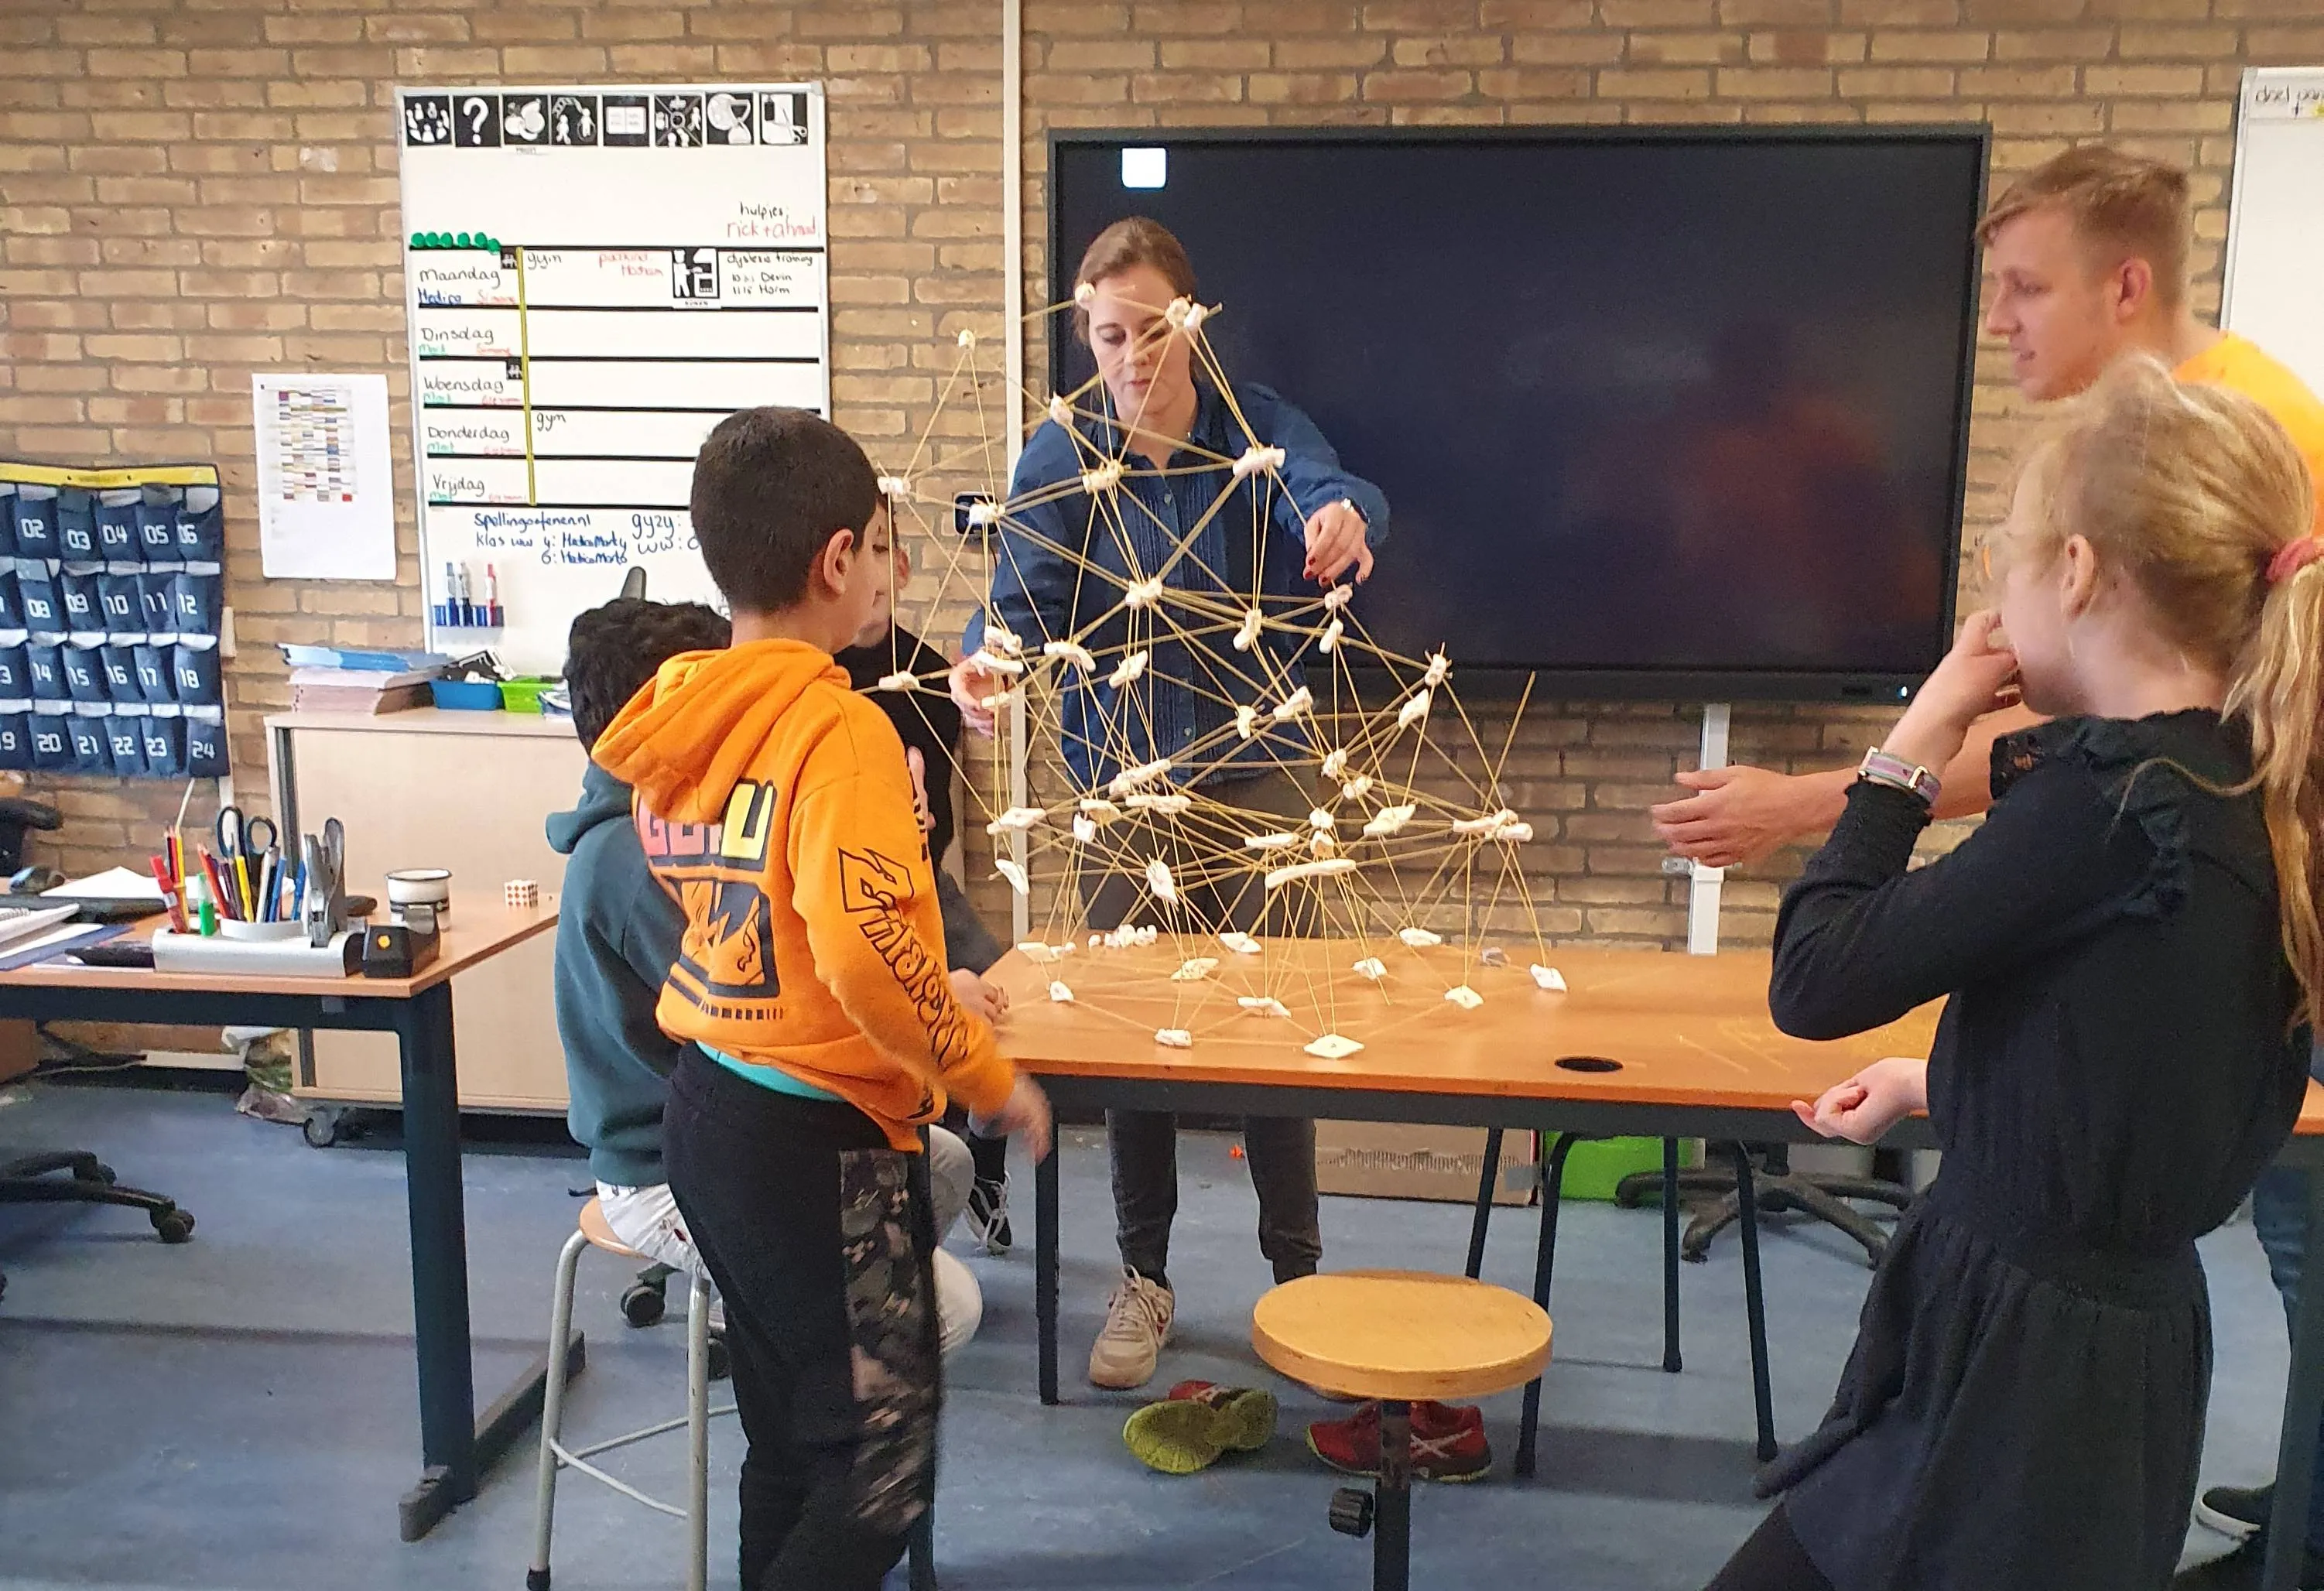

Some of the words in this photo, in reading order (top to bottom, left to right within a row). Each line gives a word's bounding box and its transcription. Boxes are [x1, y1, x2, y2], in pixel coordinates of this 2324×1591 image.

[527, 252, 562, 270] gym
[419, 266, 501, 289] Maandag
[421, 327, 494, 344] Dinsdag
[423, 376, 504, 394] Woensdag
[537, 412, 566, 432] gym
[427, 426, 510, 443] Donderdag
[433, 474, 485, 497] Vrijdag
[21, 518, 46, 539] 02
[102, 524, 128, 544] 04
[144, 525, 169, 544] 05
[177, 524, 198, 544] 06
[67, 529, 91, 550] 03
[27, 598, 51, 618] 08
[65, 593, 89, 613] 09
[105, 594, 129, 614] 10
[145, 592, 167, 613] 11
[179, 593, 197, 614] 12
[0, 665, 12, 685] 3
[33, 662, 52, 682] 14
[67, 666, 90, 686] 15
[106, 665, 128, 684] 16
[139, 667, 157, 686] 17
[180, 668, 200, 688] 18
[0, 731, 15, 751] 9
[36, 733, 63, 753] 20
[78, 736, 99, 754] 21
[113, 736, 135, 755] 22
[145, 737, 167, 757] 23
[192, 741, 215, 759] 24
[638, 783, 775, 860] GU
